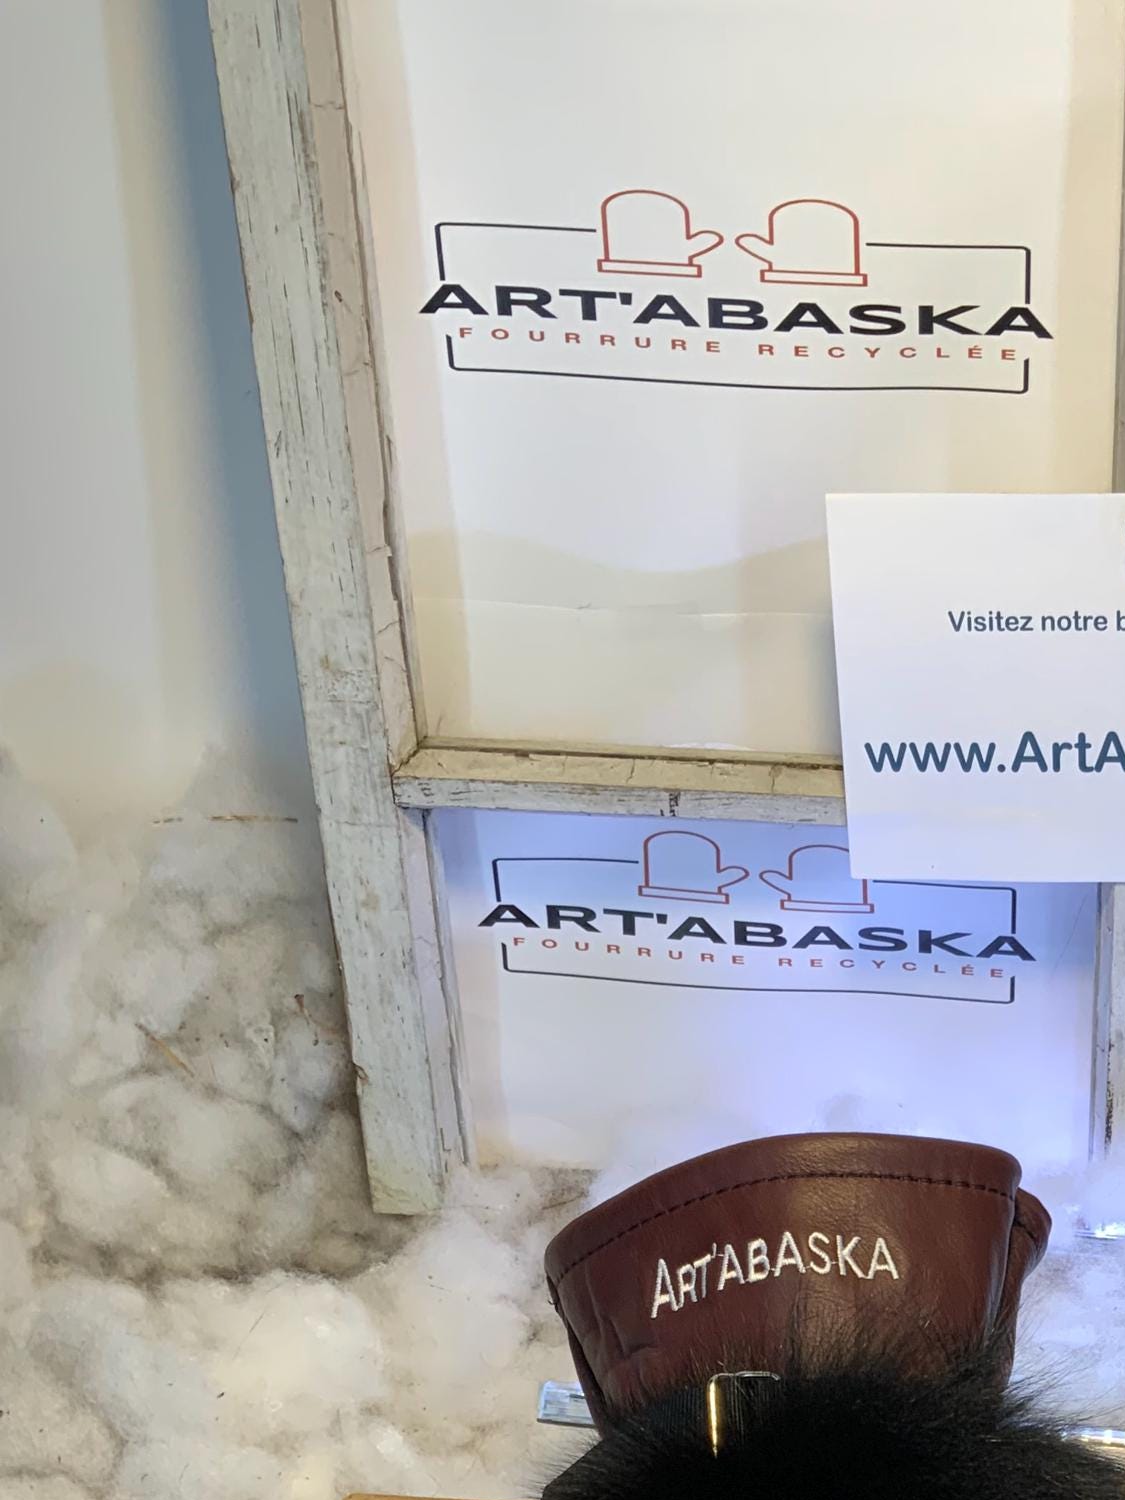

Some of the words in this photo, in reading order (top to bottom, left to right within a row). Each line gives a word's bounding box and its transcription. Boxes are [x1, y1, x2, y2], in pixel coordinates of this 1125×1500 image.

[419, 283, 1054, 340] ART'ABASKA
[459, 327, 722, 353] FOURRURE
[757, 343, 1017, 361] RECYCLÉE
[949, 611, 1033, 632] Visitez
[1042, 611, 1107, 632] notre
[478, 904, 1036, 962] ART'ABASKA
[512, 937, 745, 965] FOURRURE
[777, 956, 1004, 978] RECYCLÉE
[650, 1231, 899, 1319] ART'ABASKA
